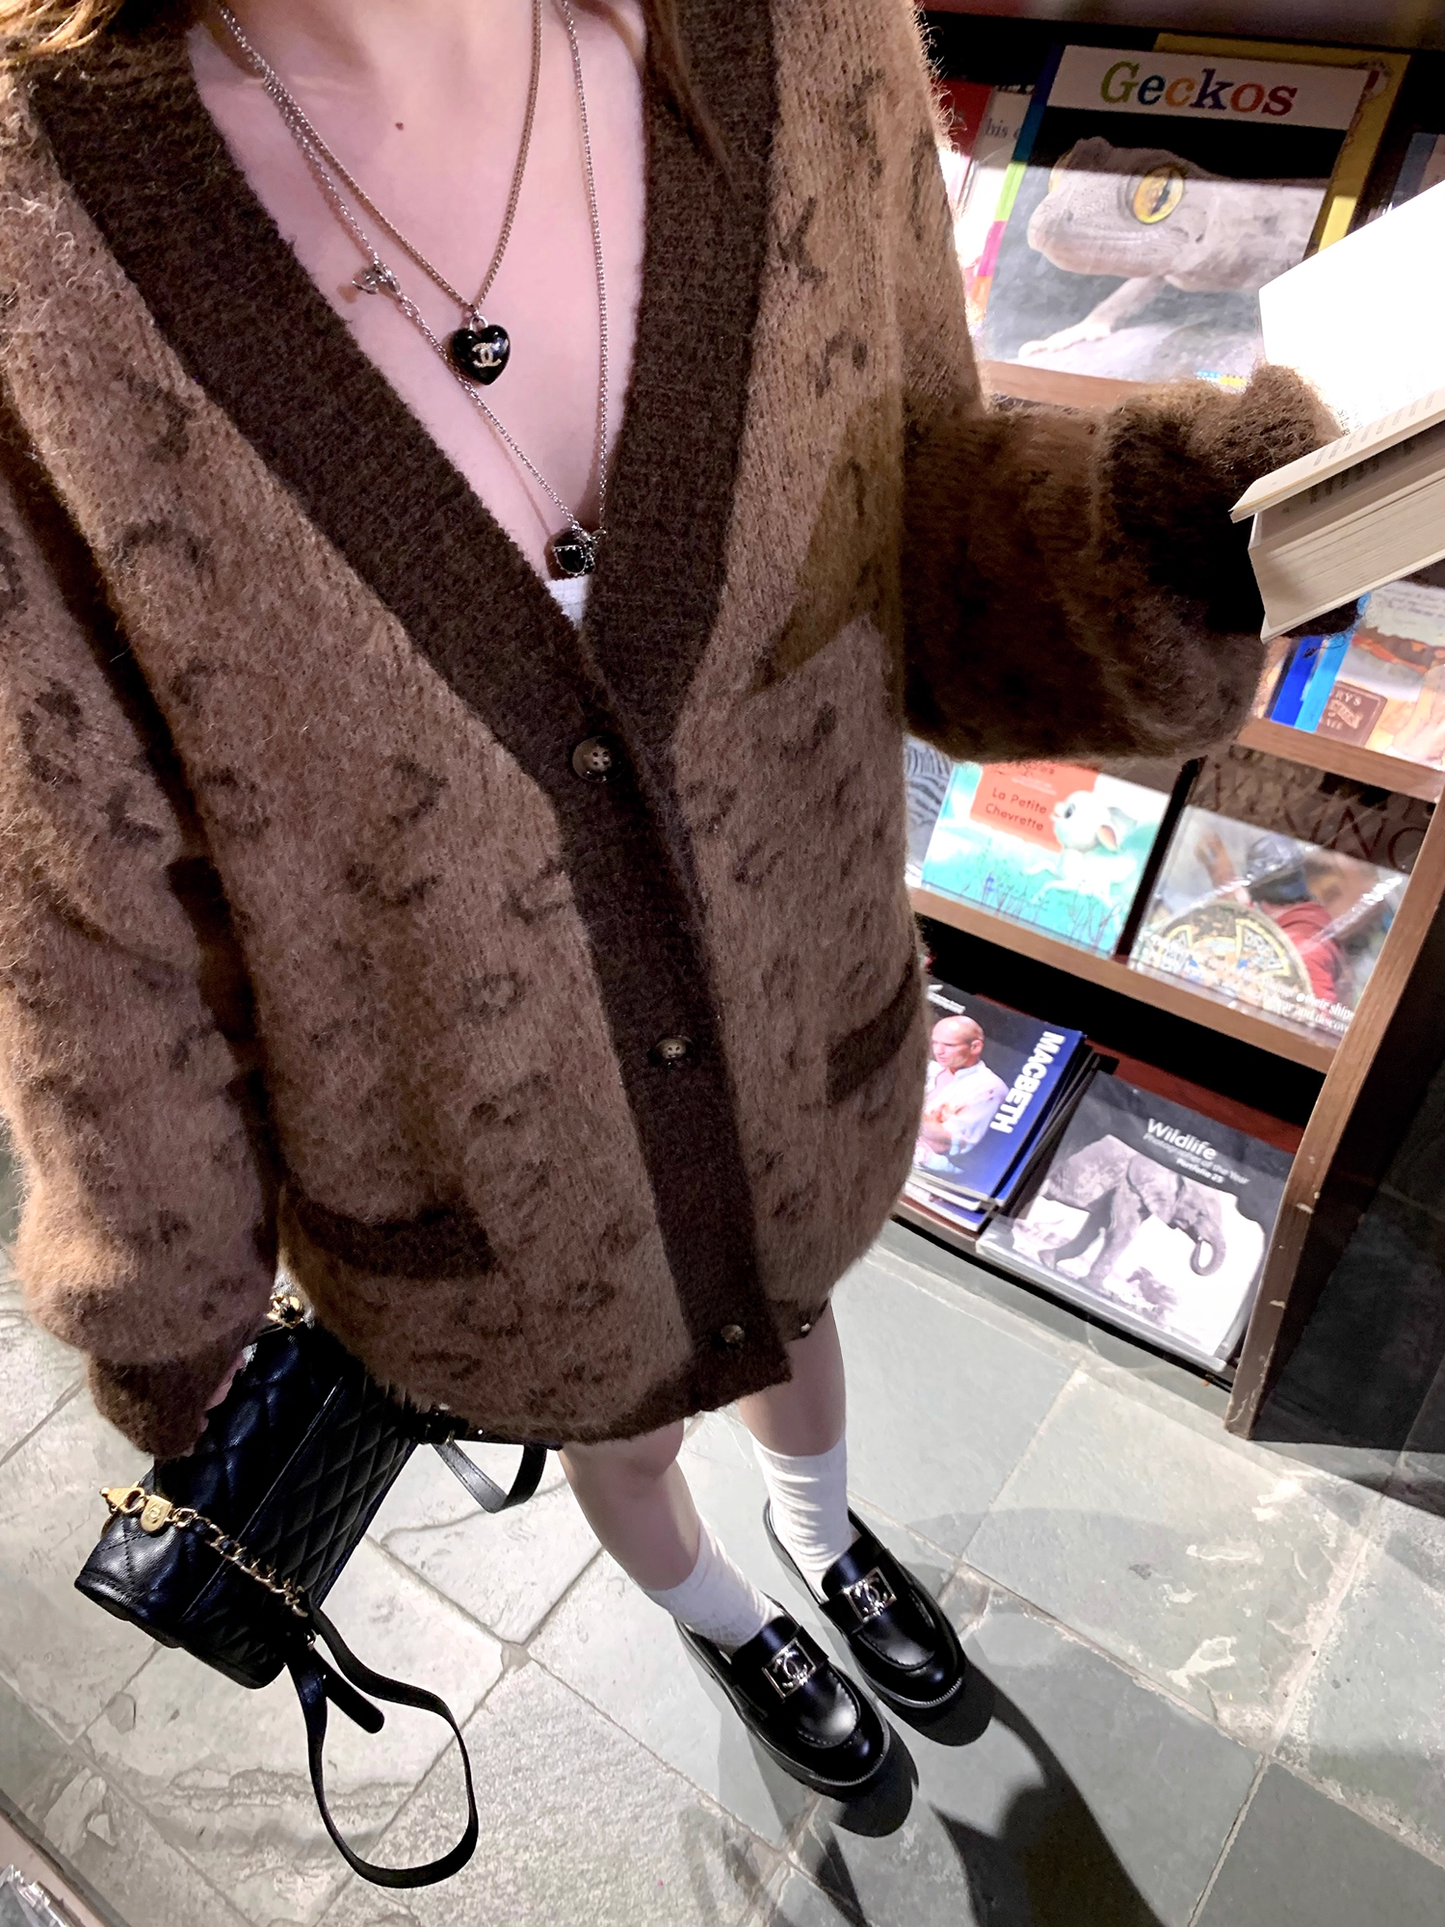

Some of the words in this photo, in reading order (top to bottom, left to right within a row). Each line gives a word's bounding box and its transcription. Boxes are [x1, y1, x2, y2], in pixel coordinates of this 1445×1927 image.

[1100, 60, 1298, 117] Geckos
[991, 787, 1006, 801] La
[1010, 794, 1047, 814] Petite
[985, 803, 1044, 831] Chevrette
[989, 1030, 1067, 1135] MACBETH
[1148, 1118, 1217, 1160] Wildlife
[1176, 1157, 1213, 1178] Portfolio
[1212, 1163, 1230, 1176] the
[1229, 1170, 1251, 1184] Year
